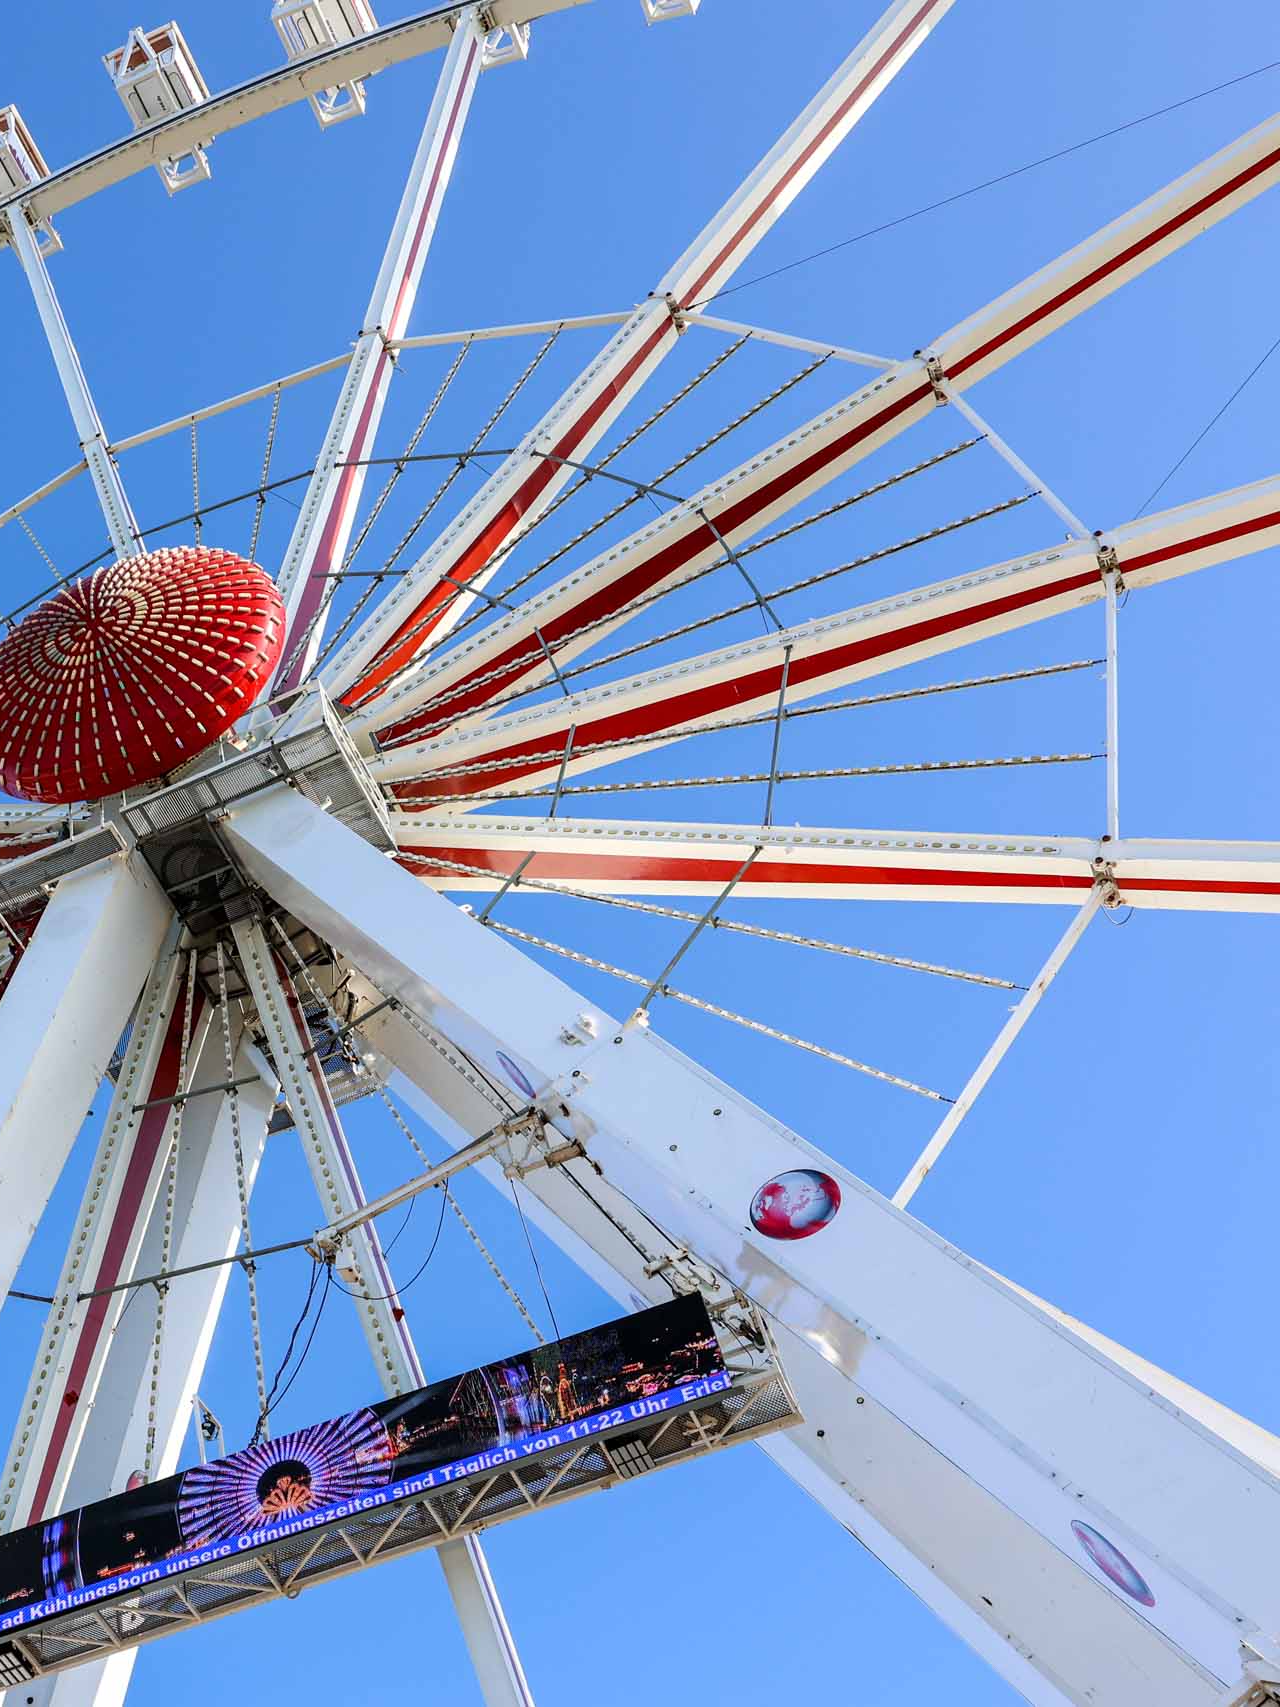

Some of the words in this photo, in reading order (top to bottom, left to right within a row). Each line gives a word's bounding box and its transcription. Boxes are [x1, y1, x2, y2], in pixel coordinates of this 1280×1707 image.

[31, 1570, 161, 1620] Kühlungsborn
[166, 1545, 231, 1574] unsere
[238, 1494, 387, 1550] Öffnungszeiten
[392, 1473, 435, 1498] sind
[440, 1448, 517, 1480] Täglich
[523, 1434, 561, 1453] von
[567, 1411, 625, 1440] 11-22
[630, 1397, 669, 1418] Uhr
